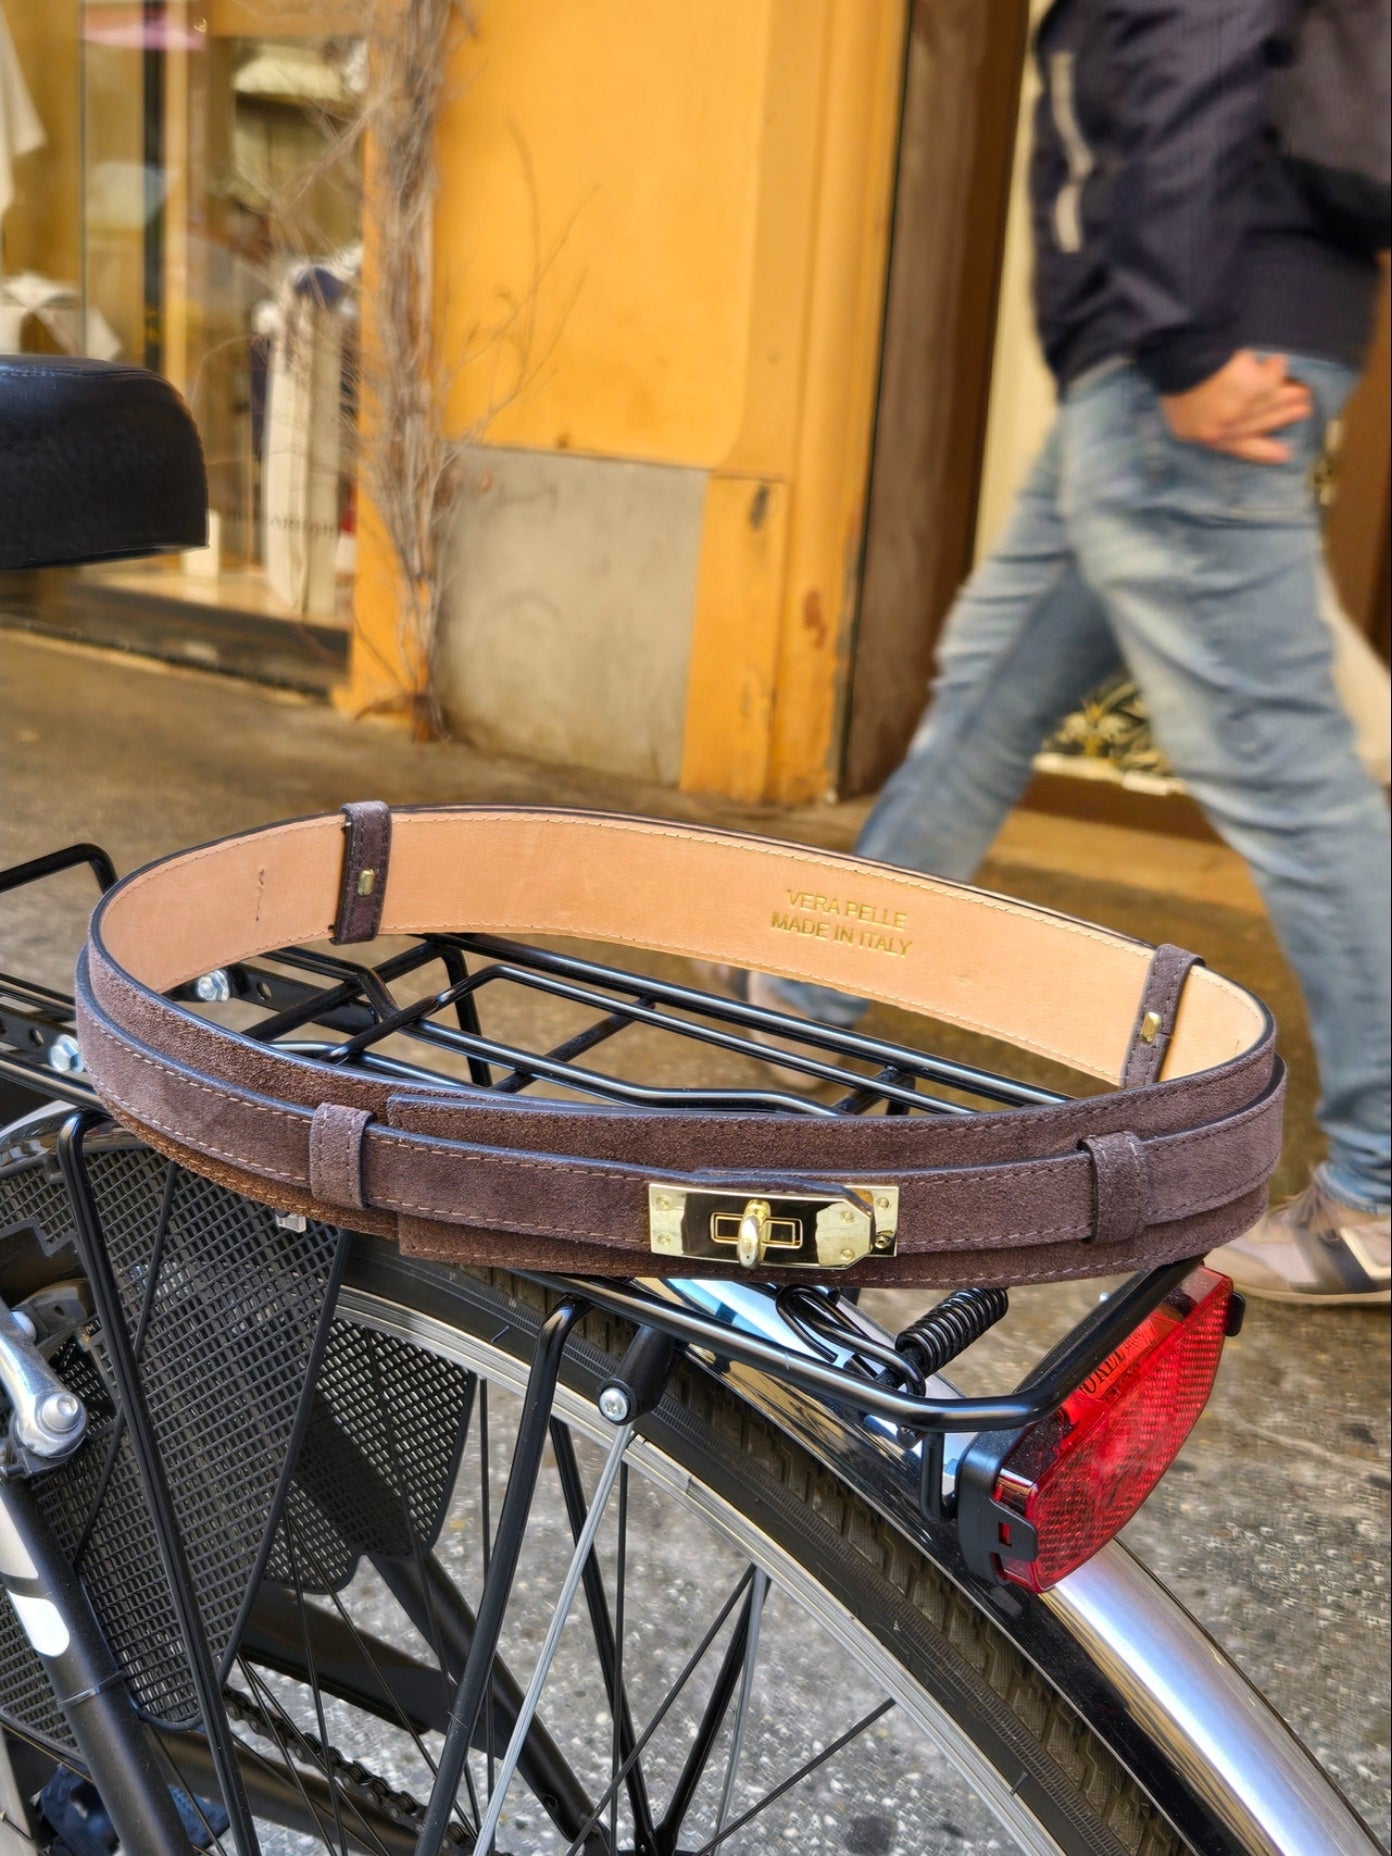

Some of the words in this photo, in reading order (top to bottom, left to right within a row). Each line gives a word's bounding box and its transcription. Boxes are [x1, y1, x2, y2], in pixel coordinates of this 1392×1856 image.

[787, 889, 840, 915] VERA
[845, 900, 908, 931] PELLE
[771, 911, 830, 940] MADE
[834, 924, 854, 945] IN
[859, 930, 913, 957] ITALY
